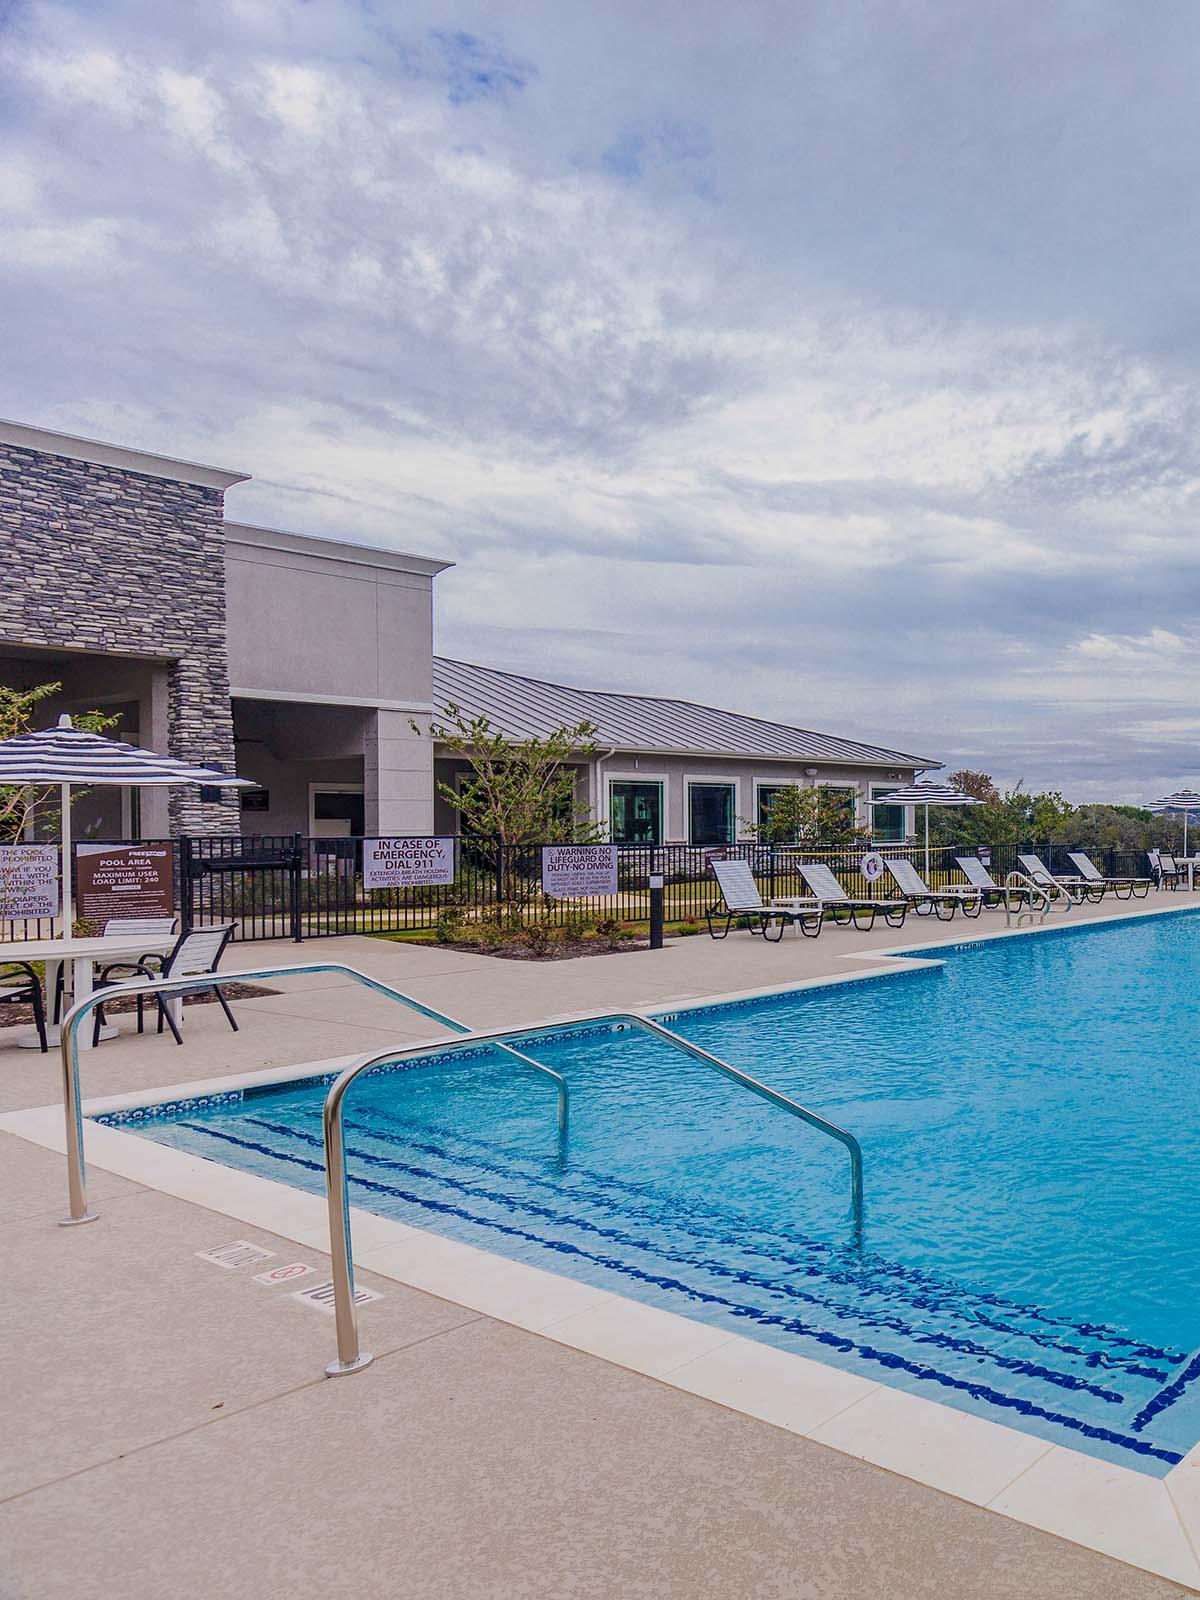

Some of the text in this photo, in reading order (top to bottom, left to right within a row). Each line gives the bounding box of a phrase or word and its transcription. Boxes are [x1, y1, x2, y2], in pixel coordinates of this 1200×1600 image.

[378, 840, 441, 849] IN CASE OF
[373, 849, 446, 860] EMERGENCY,
[557, 847, 612, 856] WARNING NO
[550, 856, 597, 864] LIFEGUARD
[385, 860, 433, 870] DIAL 911
[587, 862, 613, 870] DIVING
[93, 871, 136, 879] MAXIMUM
